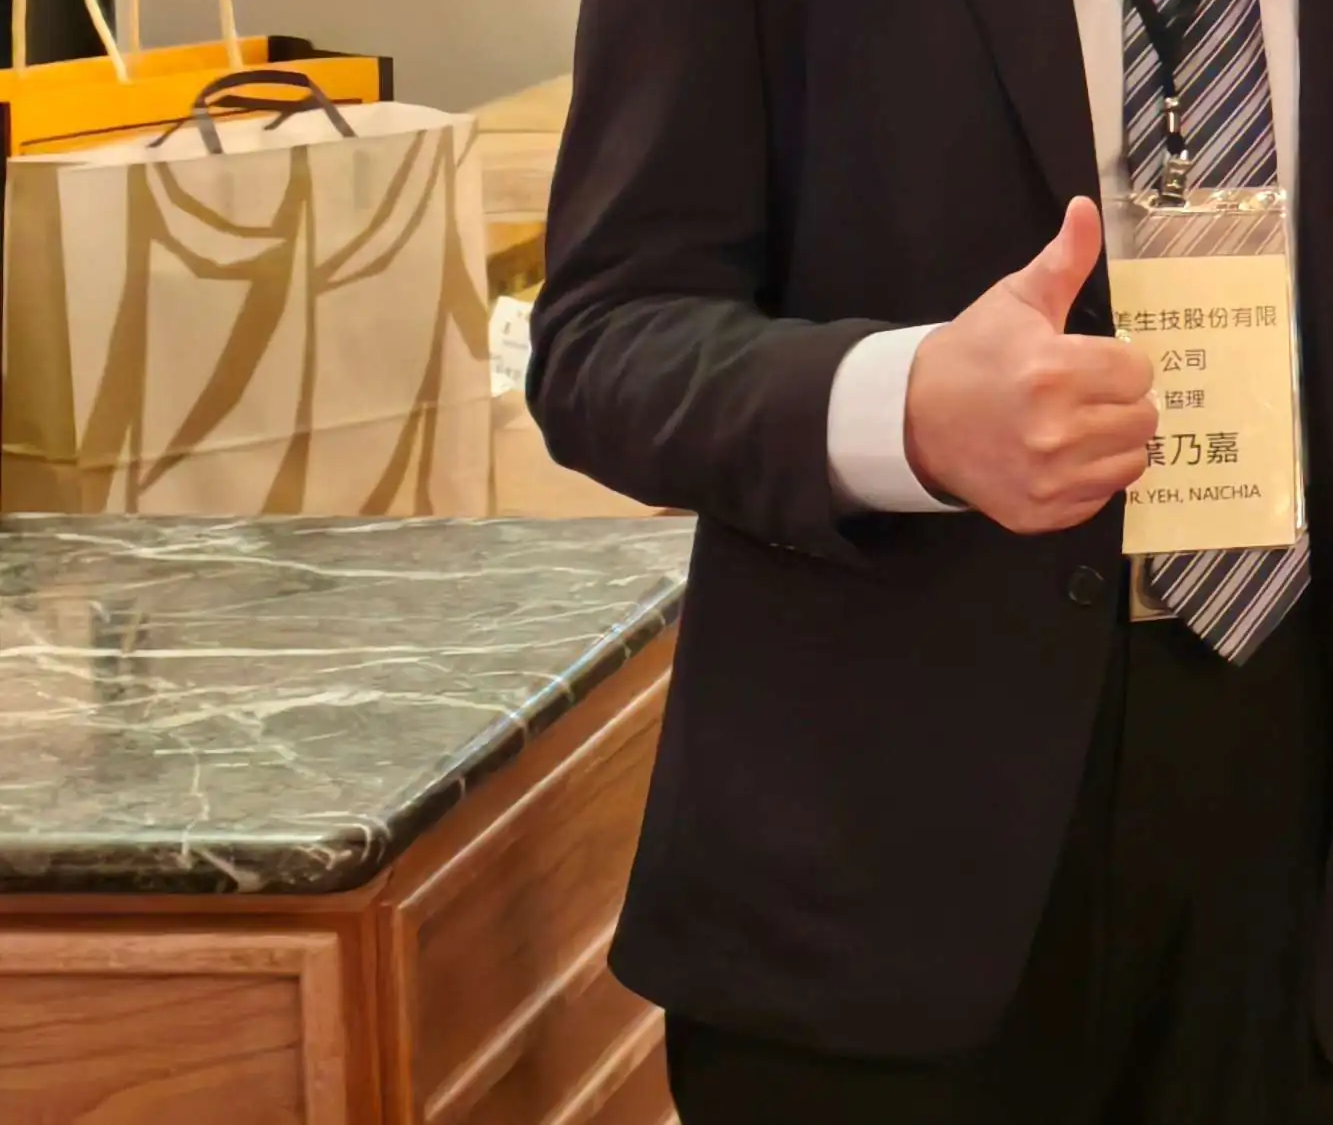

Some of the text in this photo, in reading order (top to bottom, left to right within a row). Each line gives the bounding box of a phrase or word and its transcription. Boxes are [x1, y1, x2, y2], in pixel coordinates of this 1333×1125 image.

[1115, 306, 1277, 332] 美生技股份有限
[1160, 348, 1207, 373] 公司
[1165, 389, 1206, 410] 協理
[1146, 487, 1184, 505] YEH,
[1188, 484, 1262, 502] NAICHIA
